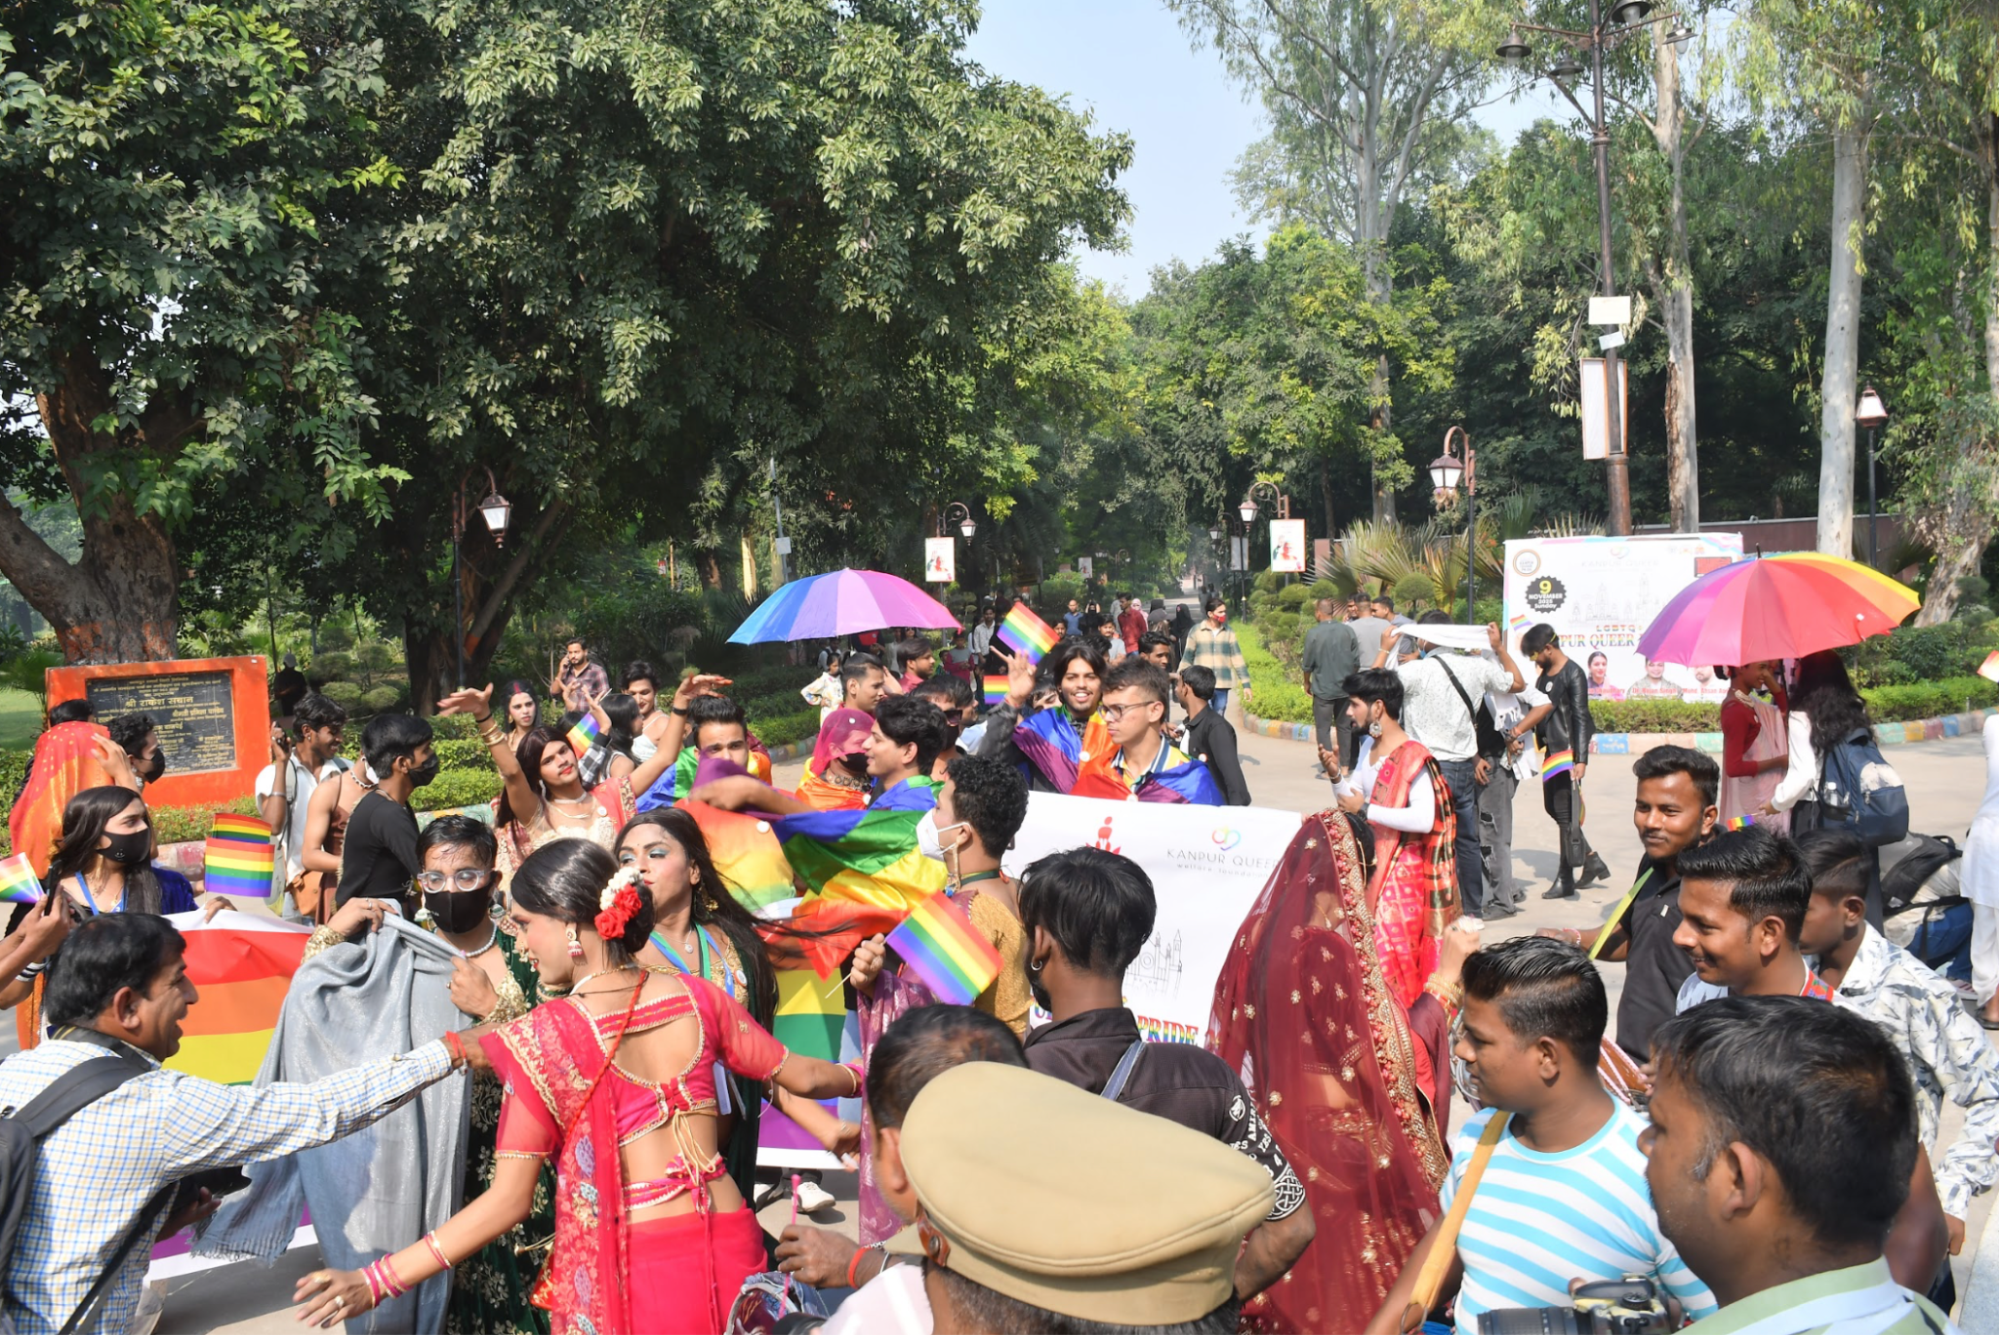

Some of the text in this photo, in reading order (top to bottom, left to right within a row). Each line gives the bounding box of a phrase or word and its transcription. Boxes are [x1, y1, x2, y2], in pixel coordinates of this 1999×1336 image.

[1539, 580, 1552, 594] 9
[1558, 634, 1586, 647] PUR
[1590, 633, 1635, 650] QUEER
[1167, 849, 1226, 864] KANPUR
[1137, 1015, 1199, 1045] PRIDE
